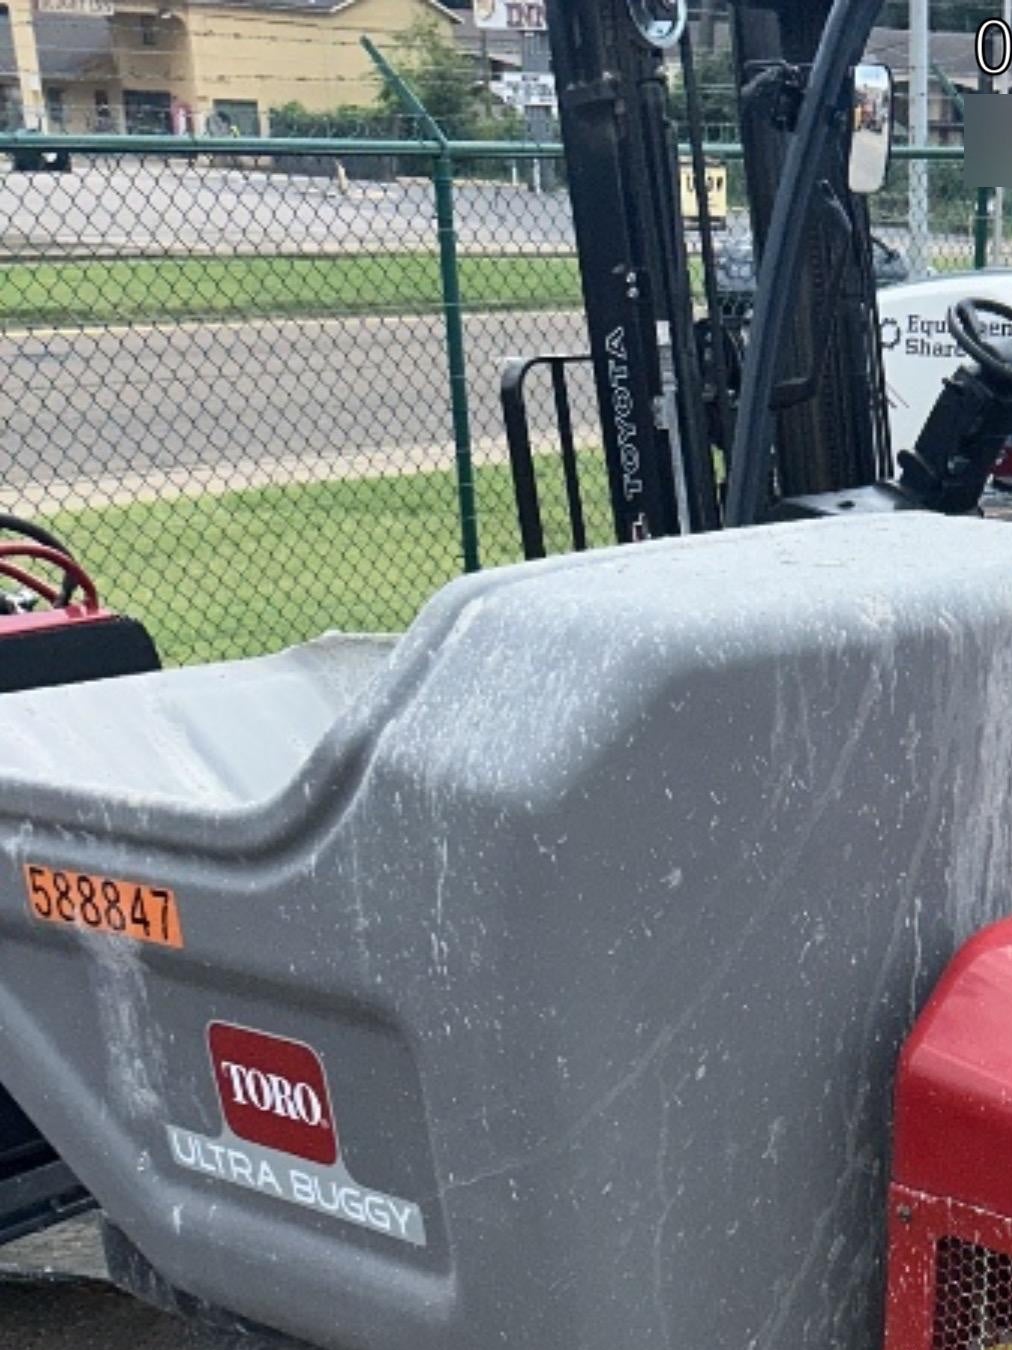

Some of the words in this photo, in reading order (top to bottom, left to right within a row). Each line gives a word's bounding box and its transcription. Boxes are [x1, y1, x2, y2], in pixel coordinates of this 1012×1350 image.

[605, 325, 643, 500] TOYOTA
[28, 866, 169, 941] 588847
[172, 1131, 283, 1195] ULTRA
[288, 1168, 413, 1236] BUGGY
